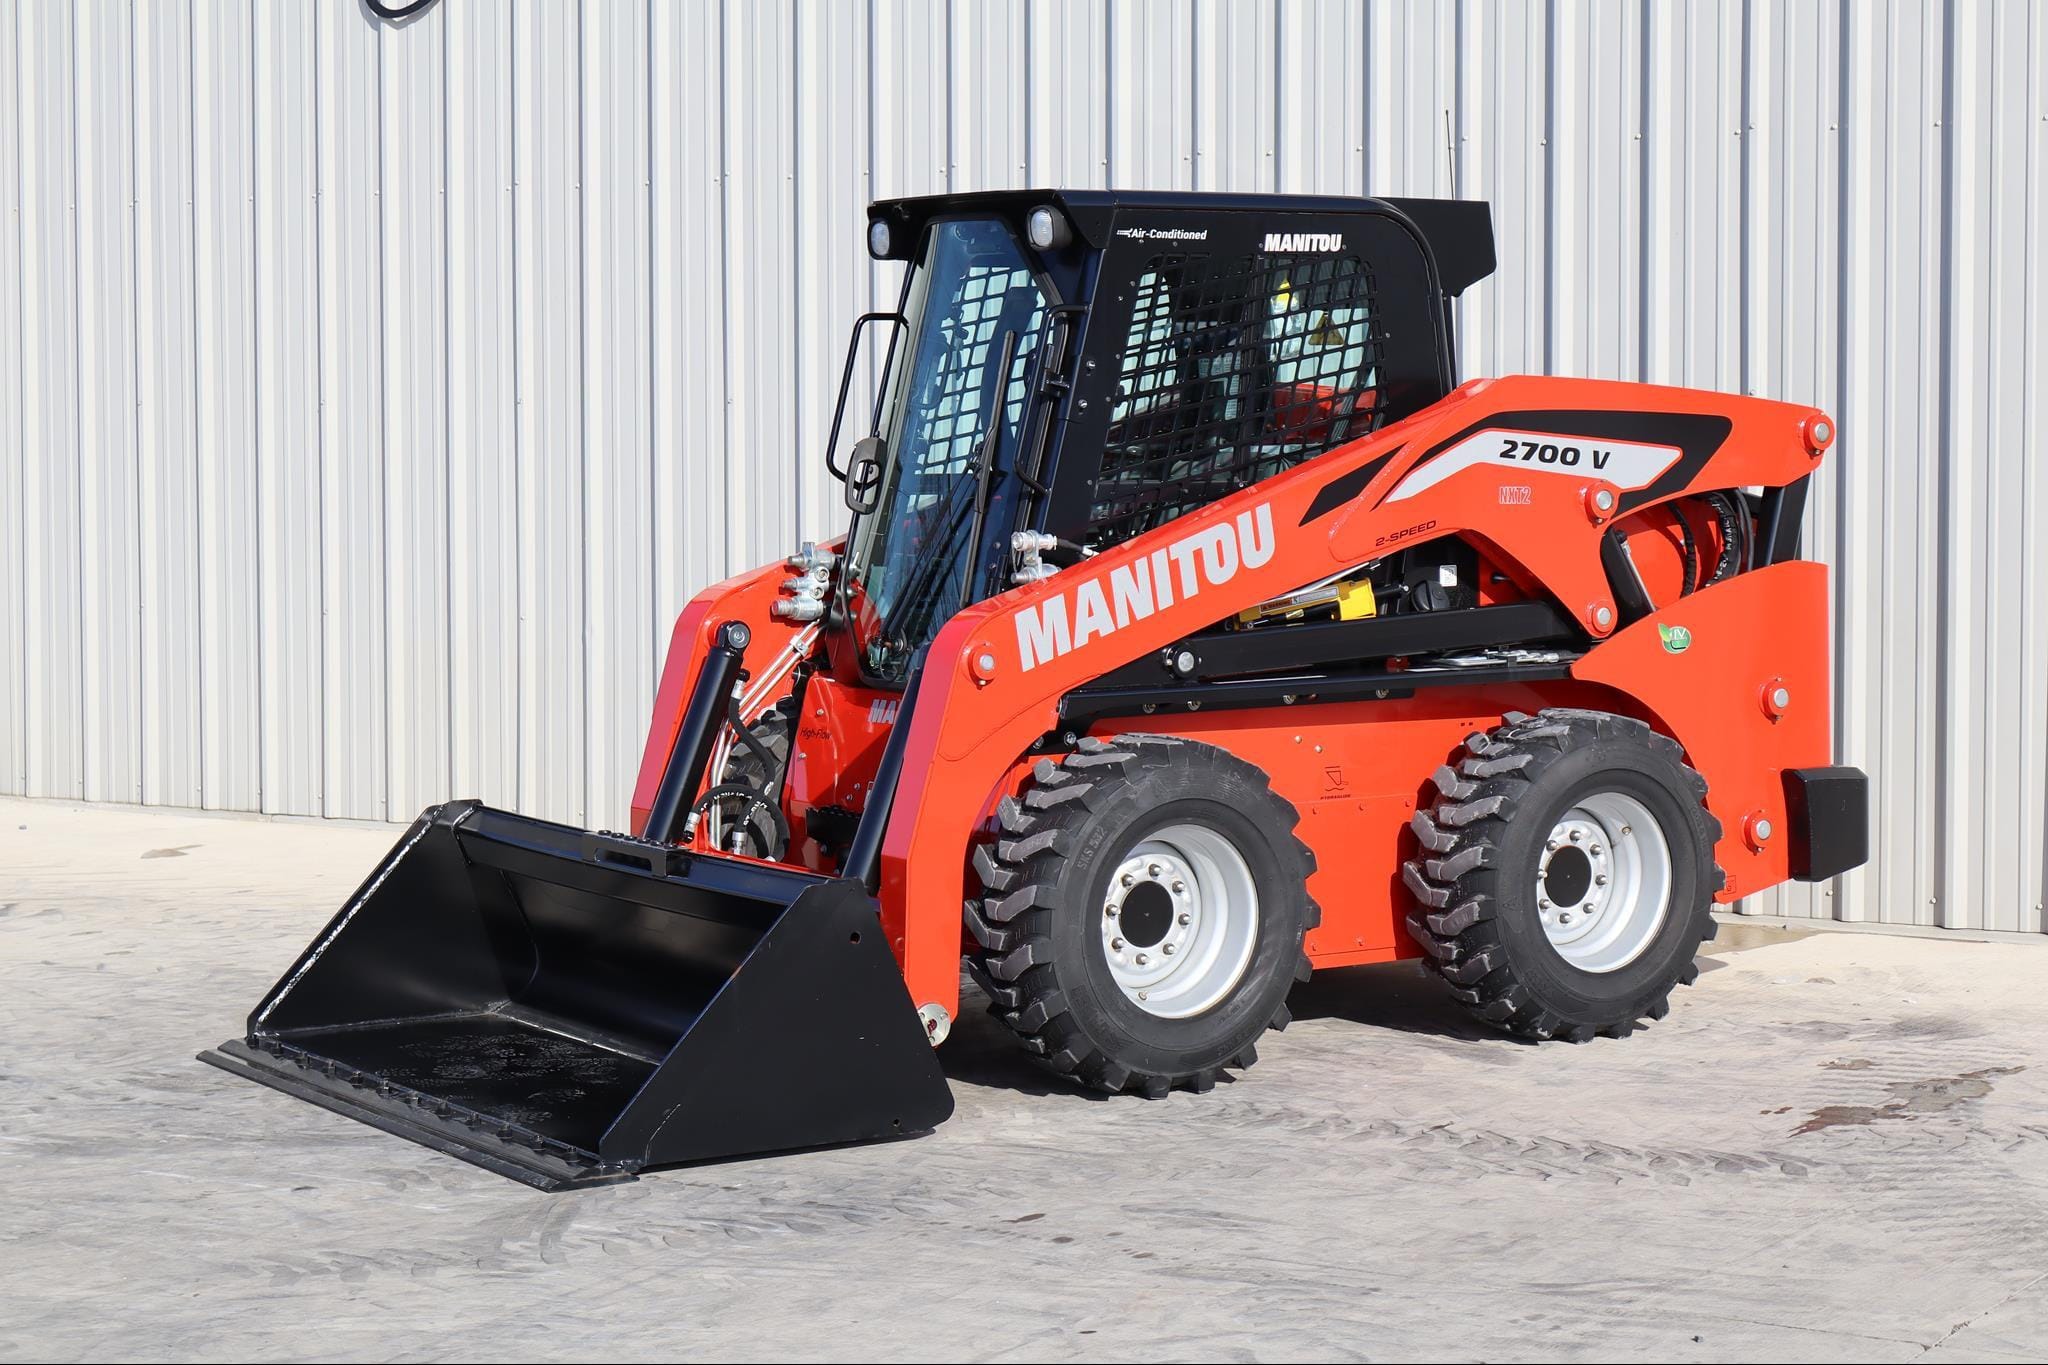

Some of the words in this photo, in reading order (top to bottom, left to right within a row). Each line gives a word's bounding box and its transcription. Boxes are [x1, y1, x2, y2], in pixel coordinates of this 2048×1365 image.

[1131, 228, 1207, 240] Air-Conditioned
[1264, 233, 1342, 252] MANITOU
[1499, 440, 1580, 465] 2700
[1593, 450, 1610, 469] V
[1499, 487, 1531, 505] NXT2
[1376, 520, 1437, 547] 2-SPEED
[1015, 503, 1276, 672] MANITOU
[800, 727, 832, 741] High-Flow
